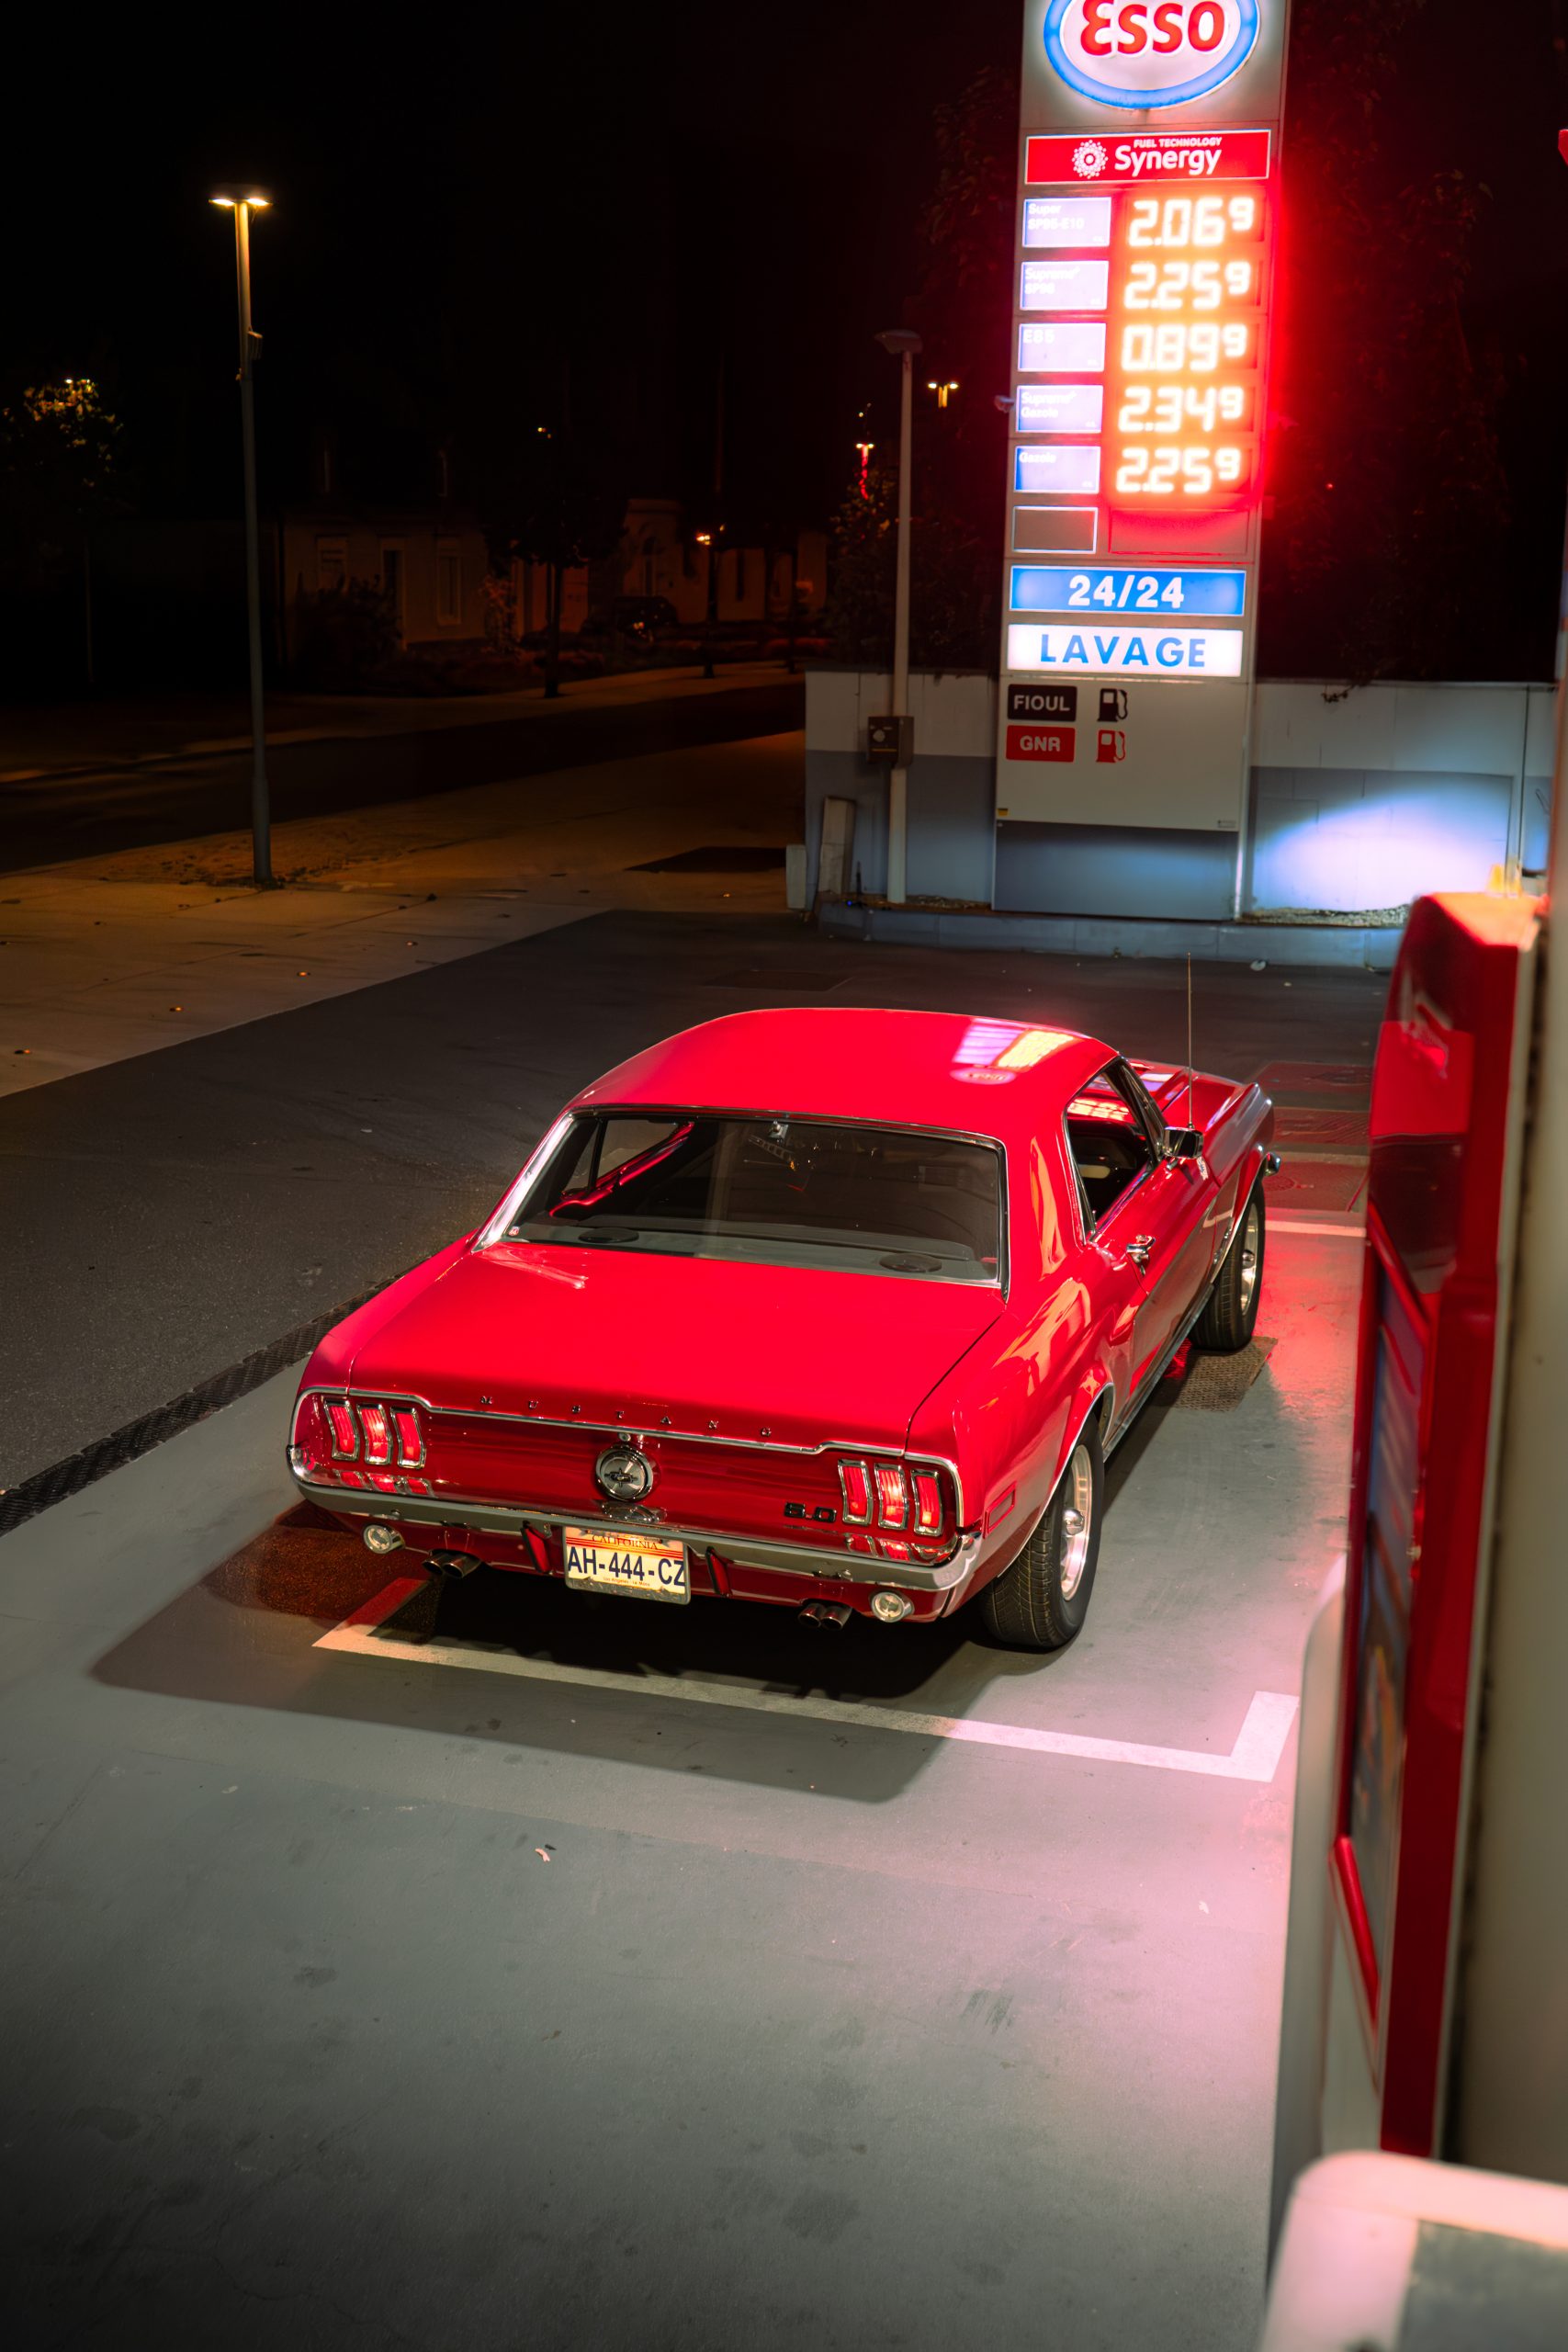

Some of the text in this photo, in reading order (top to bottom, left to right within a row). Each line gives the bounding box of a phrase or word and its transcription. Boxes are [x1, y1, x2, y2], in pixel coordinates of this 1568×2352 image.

[1134, 137, 1223, 148] FUEL TECHNOLOGY
[1114, 144, 1223, 177] Synergy
[1022, 329, 1055, 345] E85
[1068, 575, 1184, 608] 24/24
[1040, 634, 1206, 668] LAVAGE
[1013, 695, 1070, 711] FIOUL
[1020, 735, 1060, 752] GNR
[592, 1535, 658, 1550] CALIFORNIA
[569, 1546, 685, 1587] AH-444-CZ
